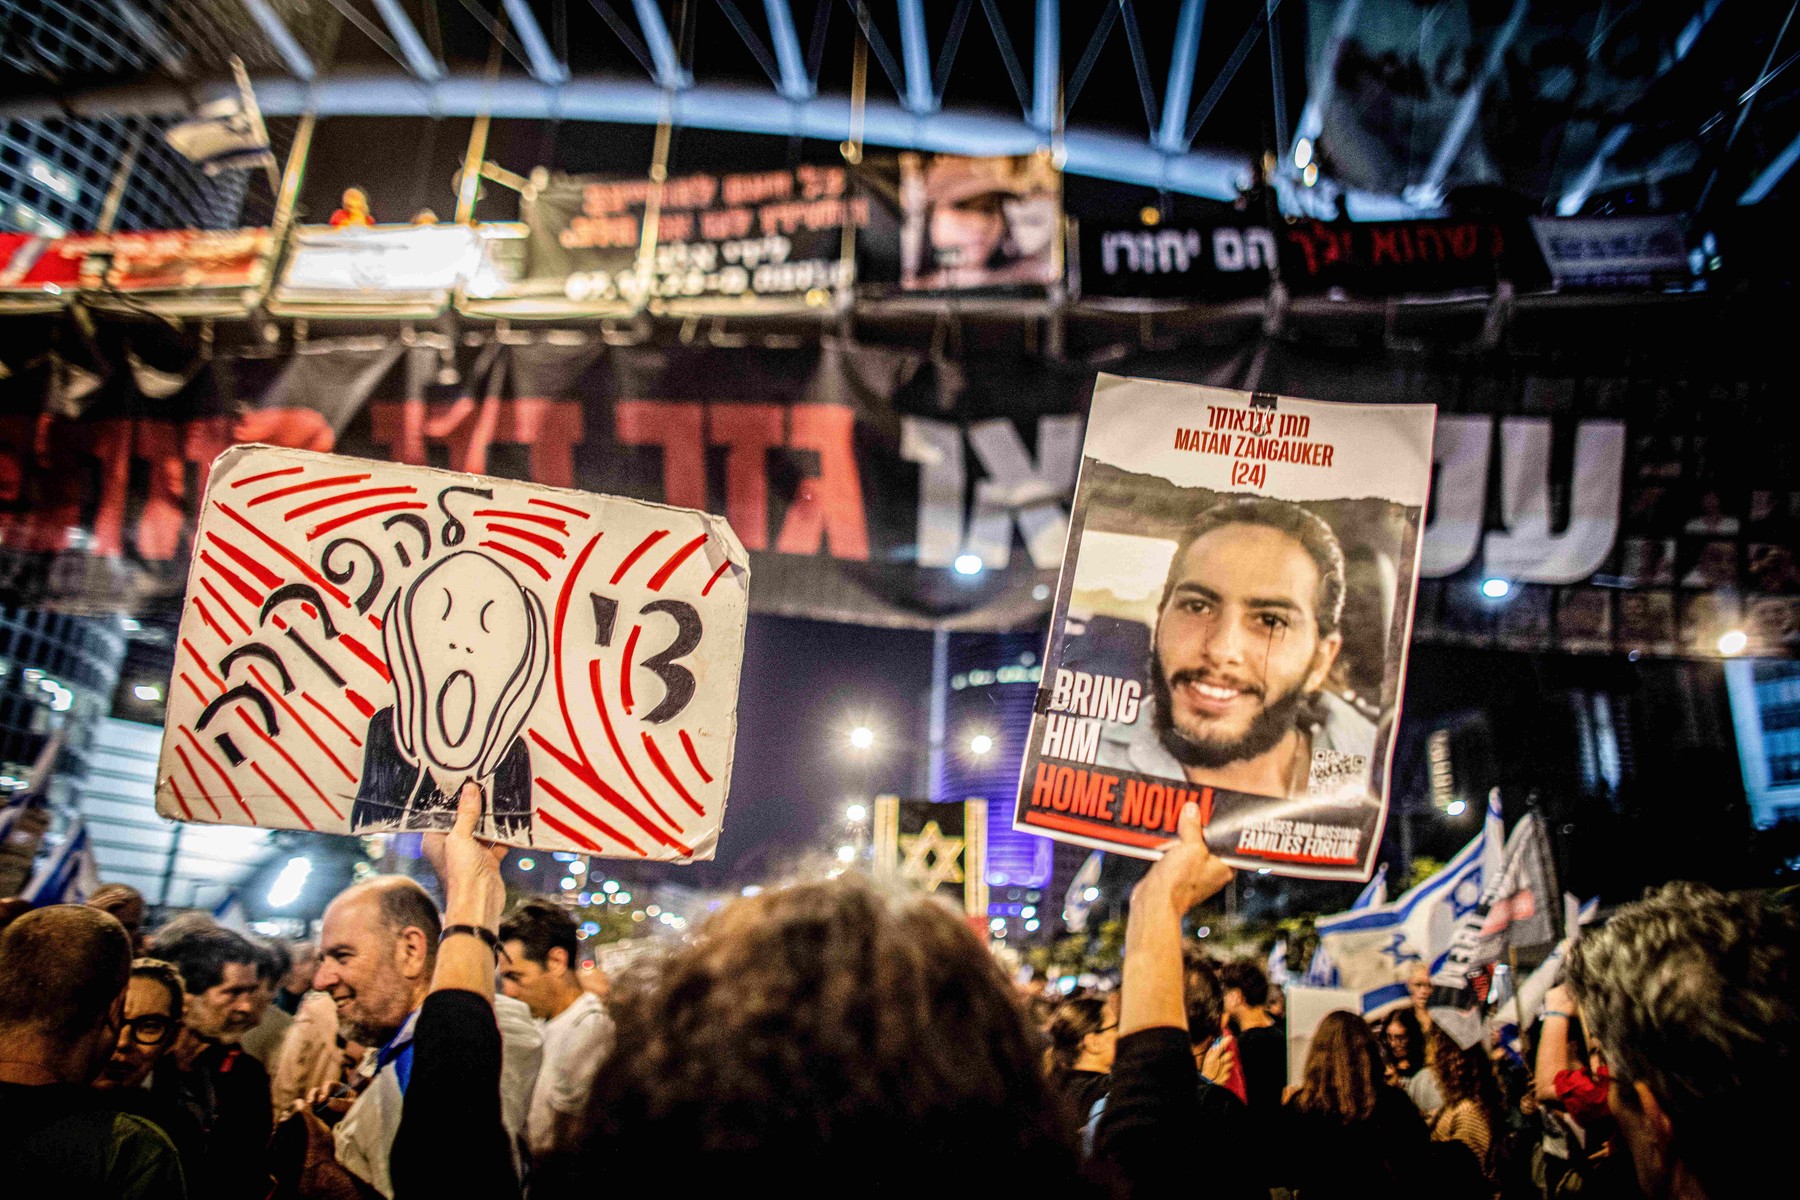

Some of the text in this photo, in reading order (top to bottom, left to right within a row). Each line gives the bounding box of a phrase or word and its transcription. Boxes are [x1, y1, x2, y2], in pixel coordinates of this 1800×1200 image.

[1212, 226, 1278, 272] הם
[1278, 413, 1311, 438] מתן
[1174, 428, 1335, 468] MATAN ZANGAUKER
[1231, 460, 1267, 489] (24)
[1050, 668, 1142, 724] BRING
[1040, 714, 1102, 765] HIM
[1031, 762, 1120, 822] HOME
[1239, 829, 1358, 860] FAMILIES FORUM
